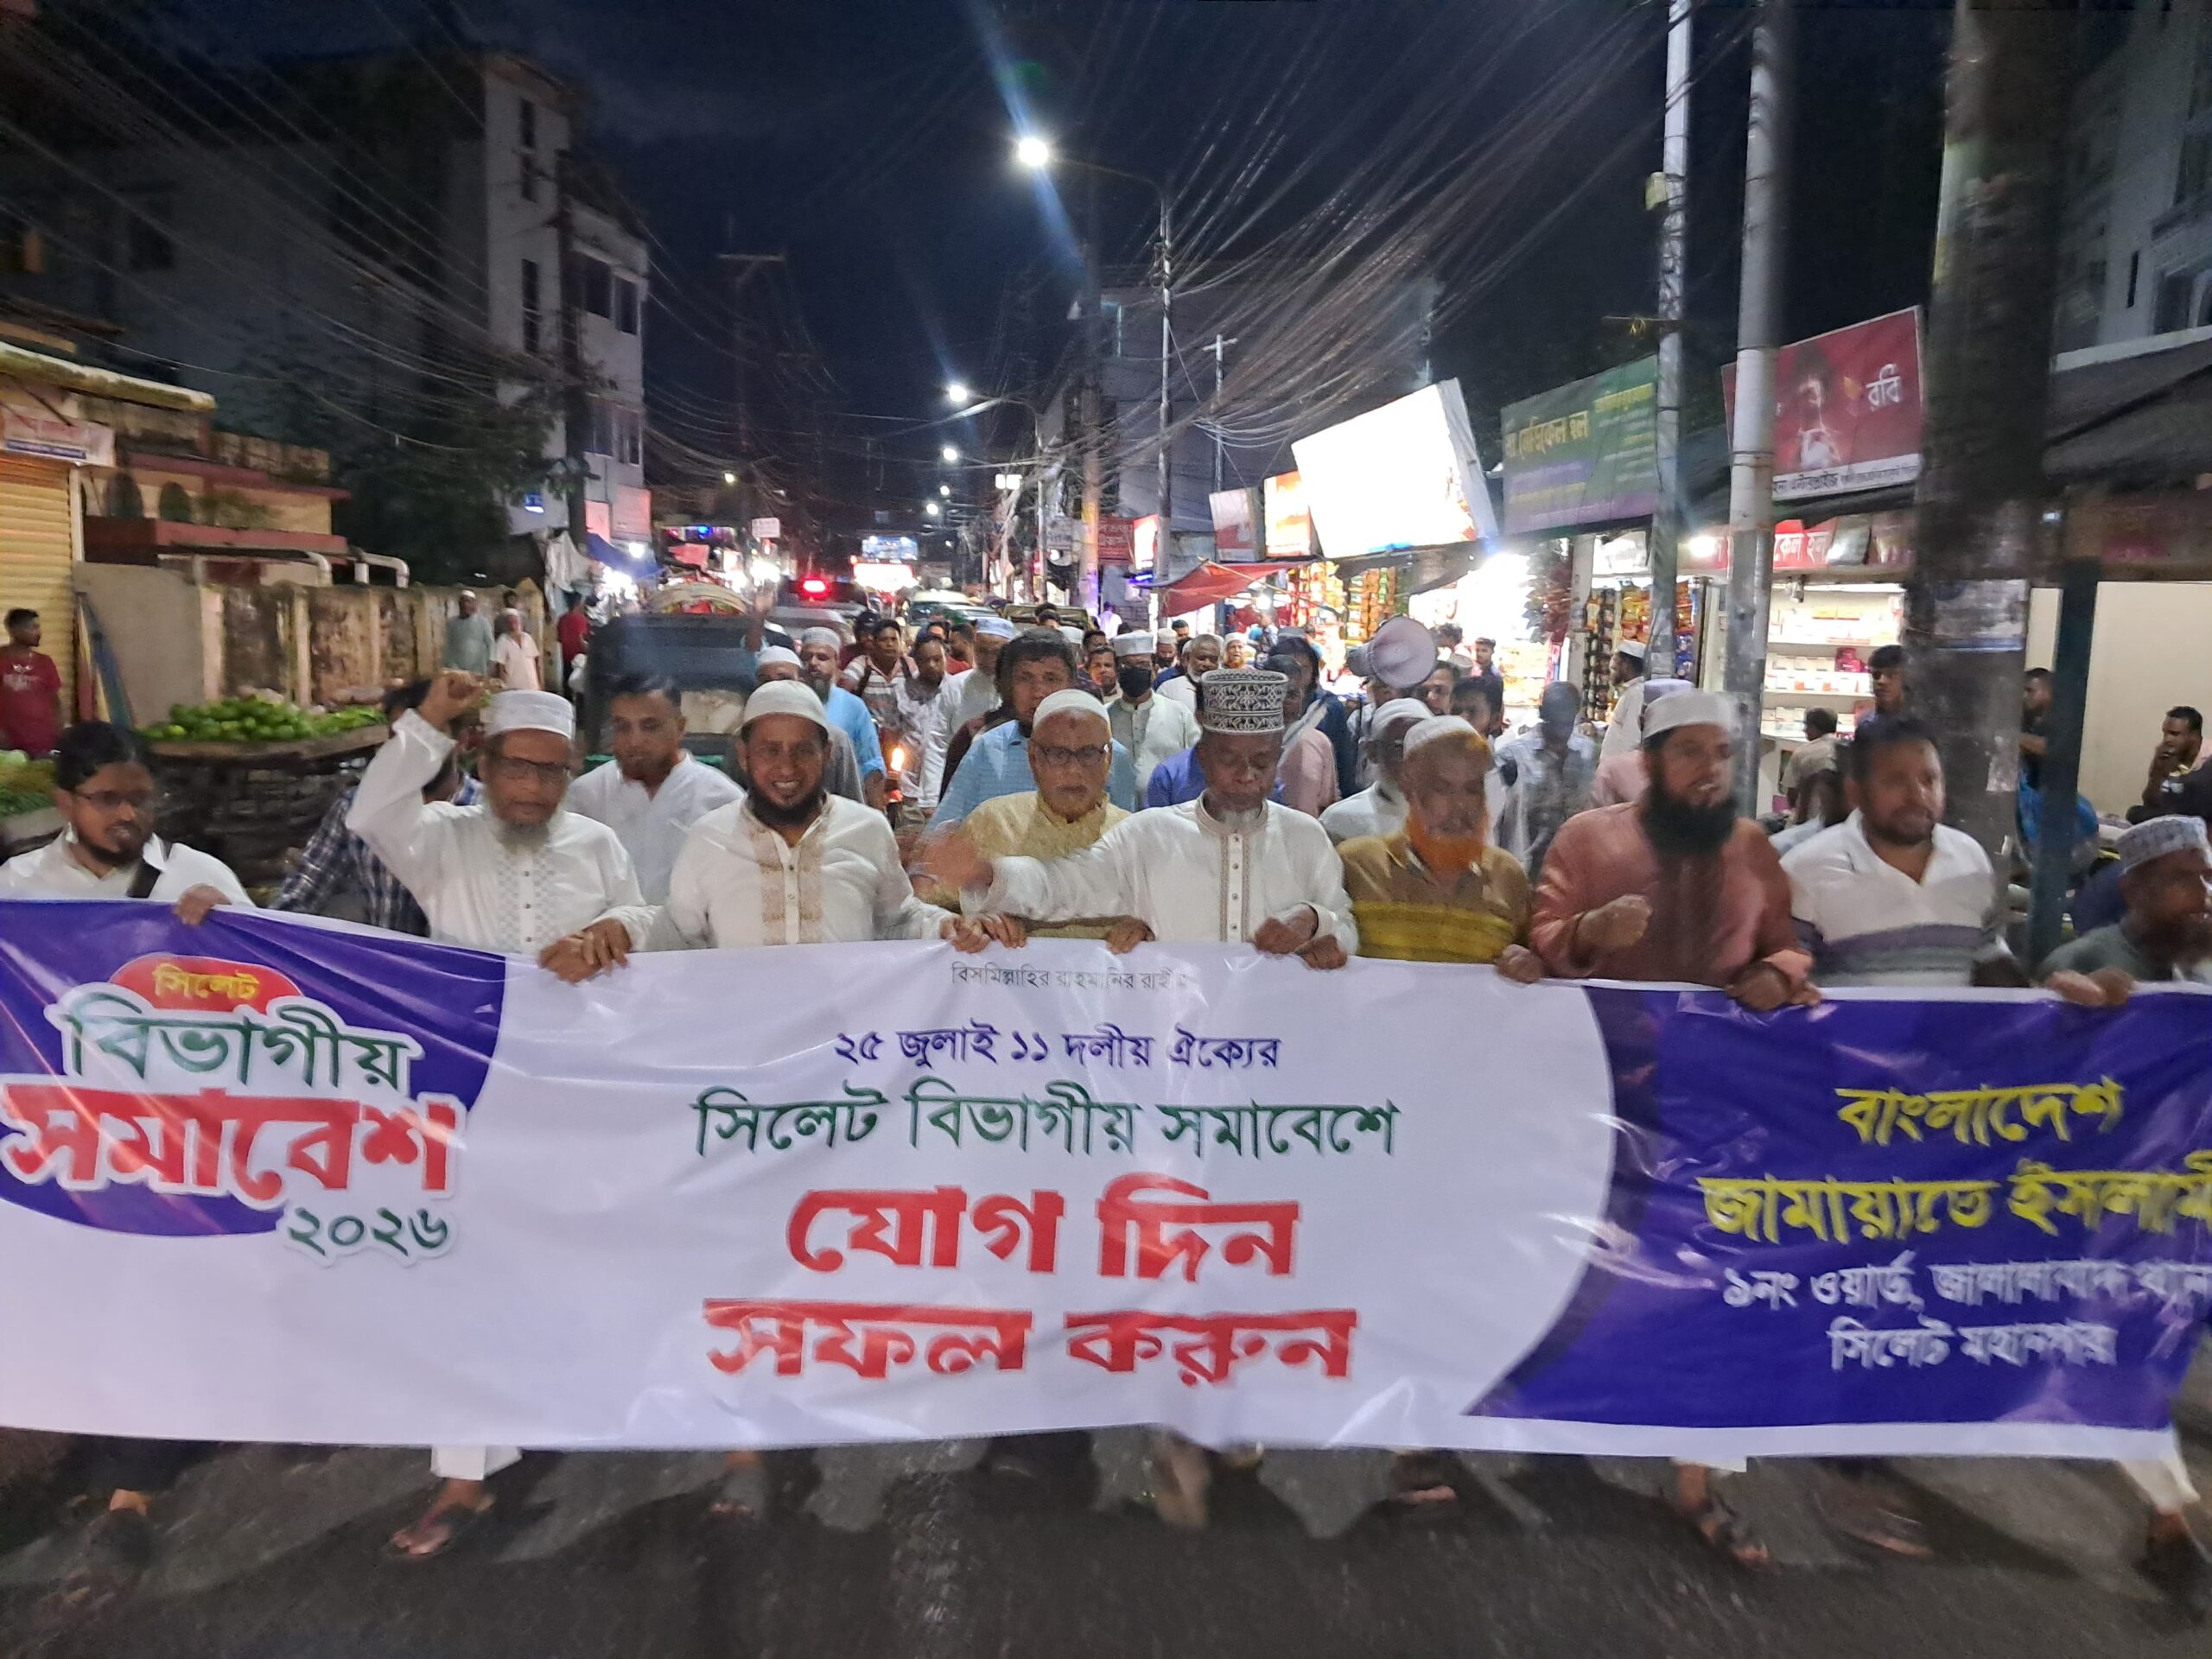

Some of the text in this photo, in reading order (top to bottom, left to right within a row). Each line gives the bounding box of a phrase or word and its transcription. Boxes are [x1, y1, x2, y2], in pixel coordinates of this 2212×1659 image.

[1865, 363, 1901, 412] রবি
[152, 963, 260, 1000] সিলেট
[950, 960, 1052, 988] বিসমিল্লাহির
[1055, 966, 1135, 989] রাহমানির
[62, 991, 410, 1092] বিভাগীয়
[835, 1017, 1281, 1070] ২৫ জুলাই ১১ দলীয় ঐক্যের
[5, 1083, 458, 1202] সমাবেশ
[691, 1076, 1402, 1159] সিলেট বিভাগীয় সমাবেশে
[1834, 1074, 2125, 1147] বাংলাদেশ
[287, 1207, 450, 1256] ২০২৬
[785, 1171, 1300, 1284] যোগ দিন
[1692, 1172, 2000, 1244] জামায়াতে
[702, 1296, 1358, 1389] সফল করুন
[1827, 1313, 1955, 1372] সিলেট
